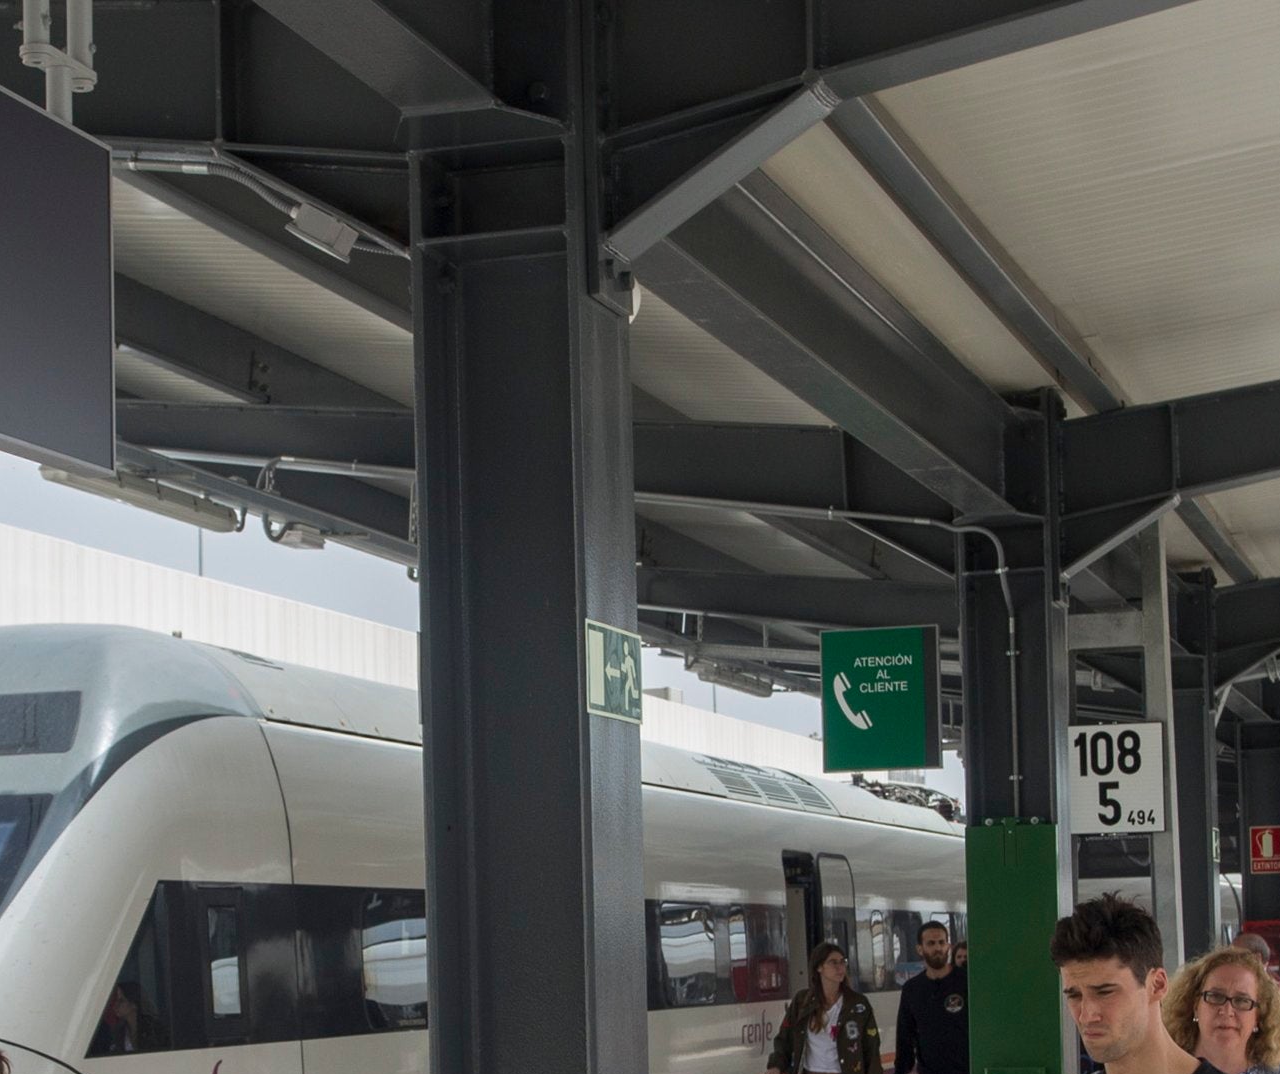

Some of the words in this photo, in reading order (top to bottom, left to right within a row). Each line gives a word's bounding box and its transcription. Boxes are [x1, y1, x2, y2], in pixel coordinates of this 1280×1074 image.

[853, 653, 913, 669] ATENCIÓN
[876, 669, 891, 680] AL
[859, 681, 909, 693] CLIENTE
[1074, 729, 1142, 777] 108
[1098, 781, 1122, 827] 5
[1127, 809, 1156, 826] 494
[741, 1009, 773, 1056] renfe
